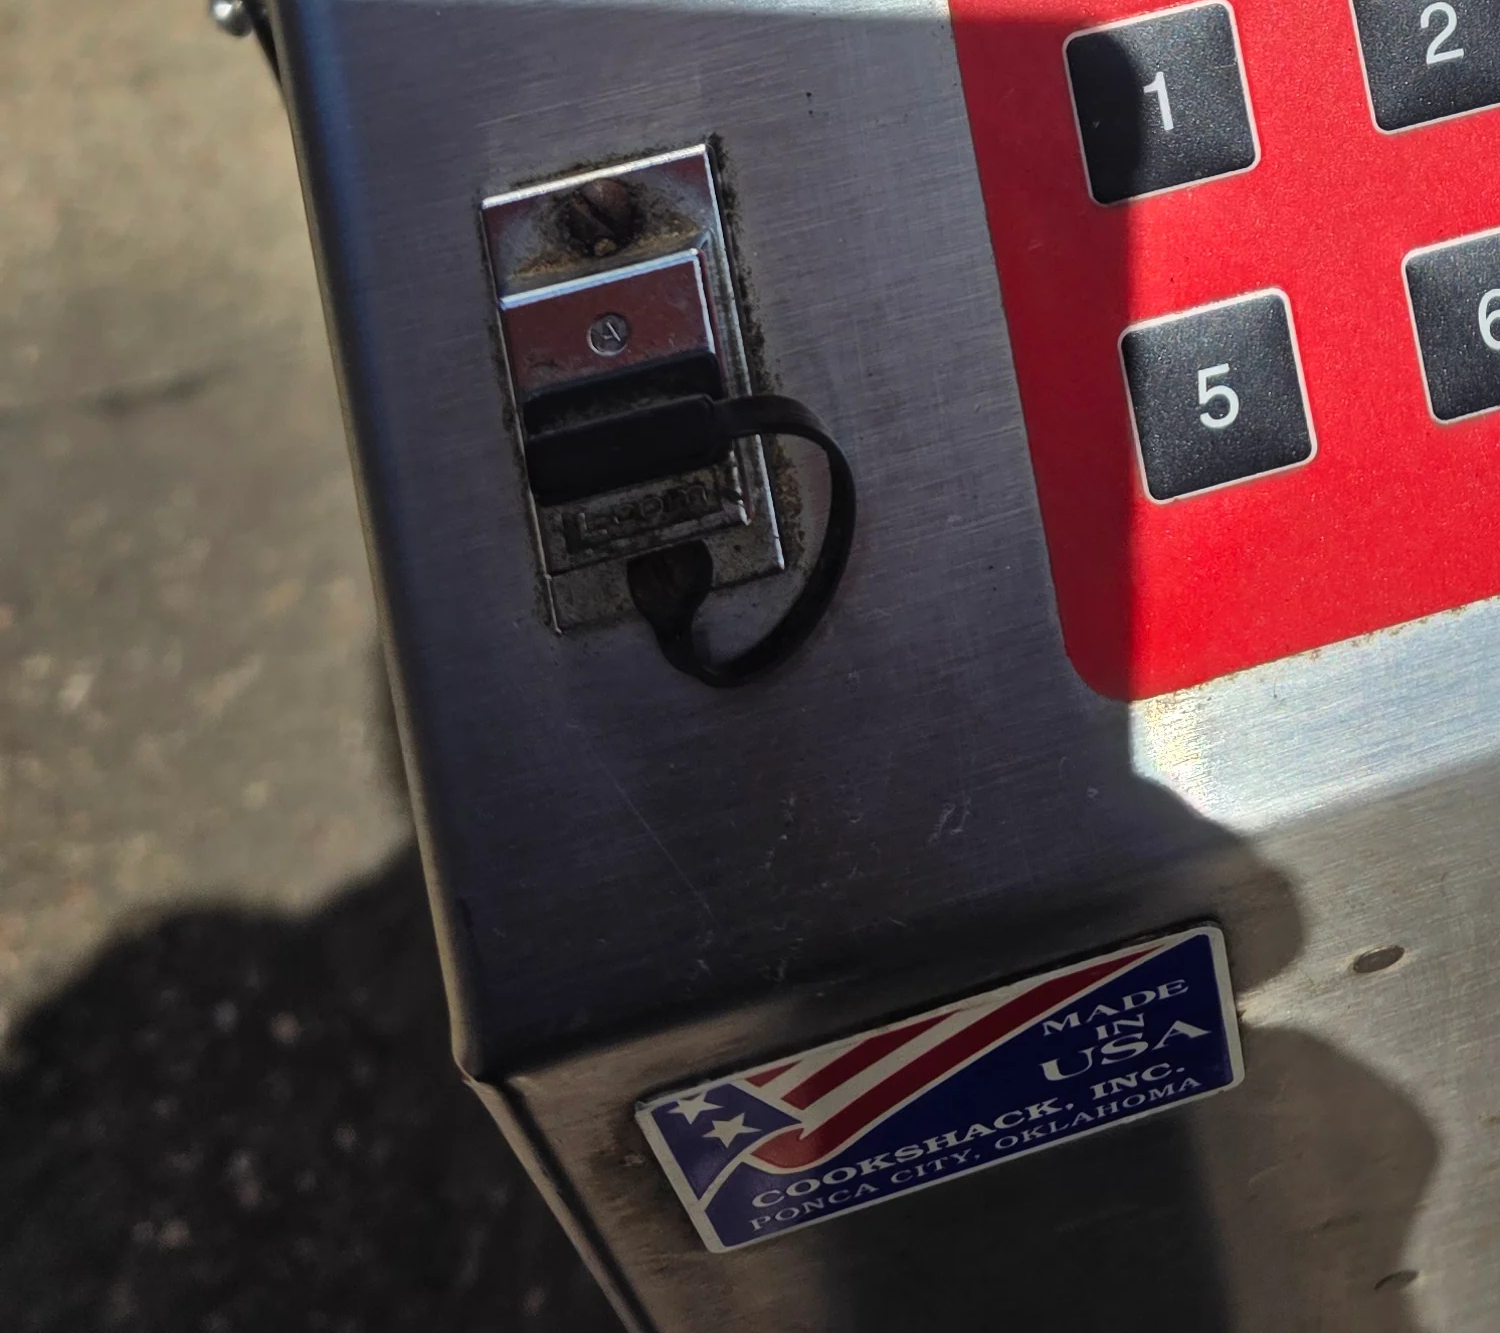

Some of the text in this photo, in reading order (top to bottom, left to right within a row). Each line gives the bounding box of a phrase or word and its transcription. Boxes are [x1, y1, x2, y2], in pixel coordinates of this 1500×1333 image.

[1420, 2, 1464, 64] 2
[1144, 71, 1174, 132] 1
[1198, 363, 1239, 428] 5
[1042, 979, 1189, 1037] MADE
[1096, 1013, 1146, 1040] IN
[1038, 1020, 1213, 1082] USA
[750, 1078, 1202, 1231] PONCA CITY, OKLAHOMA
[751, 1063, 1185, 1209] COOKSHACK, INC.
